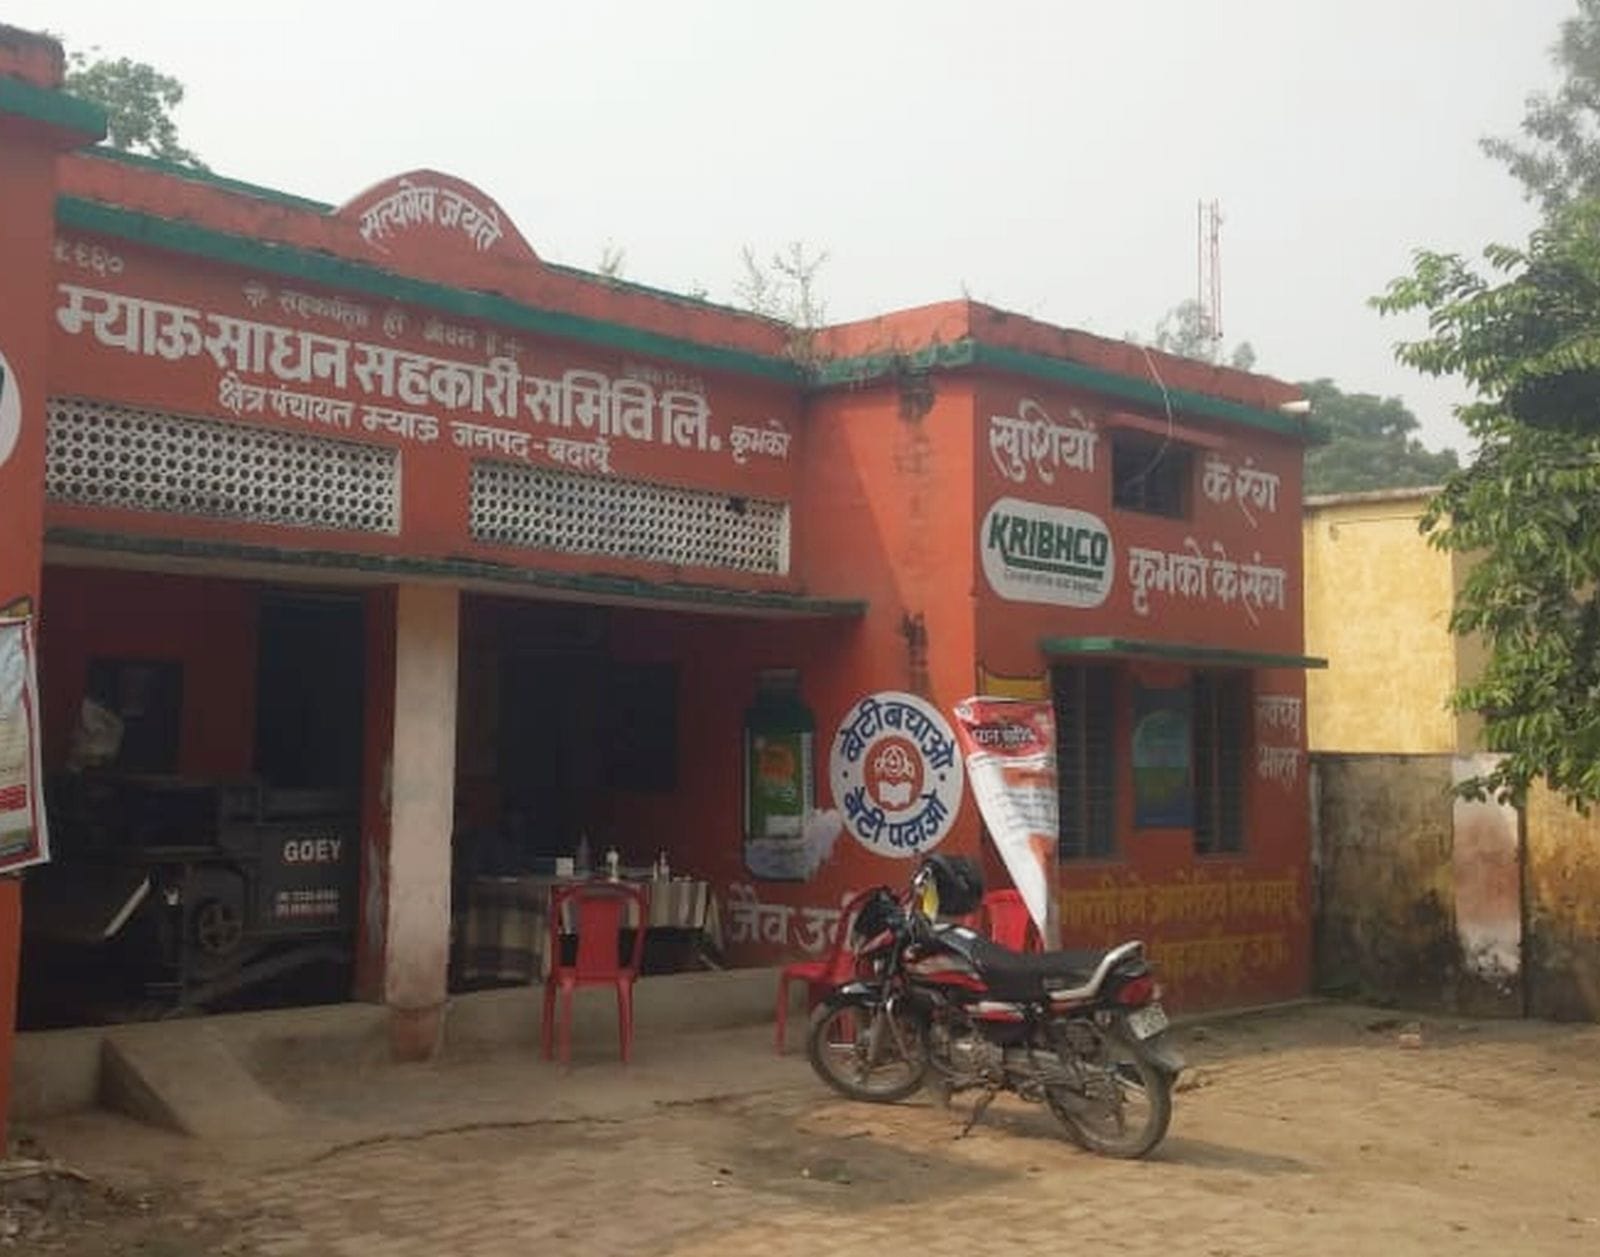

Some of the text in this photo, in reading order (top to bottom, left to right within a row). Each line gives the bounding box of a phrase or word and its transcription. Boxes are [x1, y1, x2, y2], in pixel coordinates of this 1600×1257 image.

[359, 178, 503, 254] सत्यमेव जयते
[56, 283, 203, 361] म्याऊ
[203, 312, 350, 389] साधन
[353, 341, 520, 420] सहकारी
[523, 369, 658, 442] समिति
[218, 371, 266, 417] क्षेत्र
[271, 381, 353, 430] पंचायत
[361, 403, 439, 442] म्याऊ
[989, 399, 1100, 486] खुशियों
[1235, 457, 1281, 528] रंग
[987, 511, 1109, 568] KRIBHCO
[1212, 540, 1238, 603] के
[840, 698, 955, 771] बेटी बचाओ
[727, 882, 797, 945] जैव
